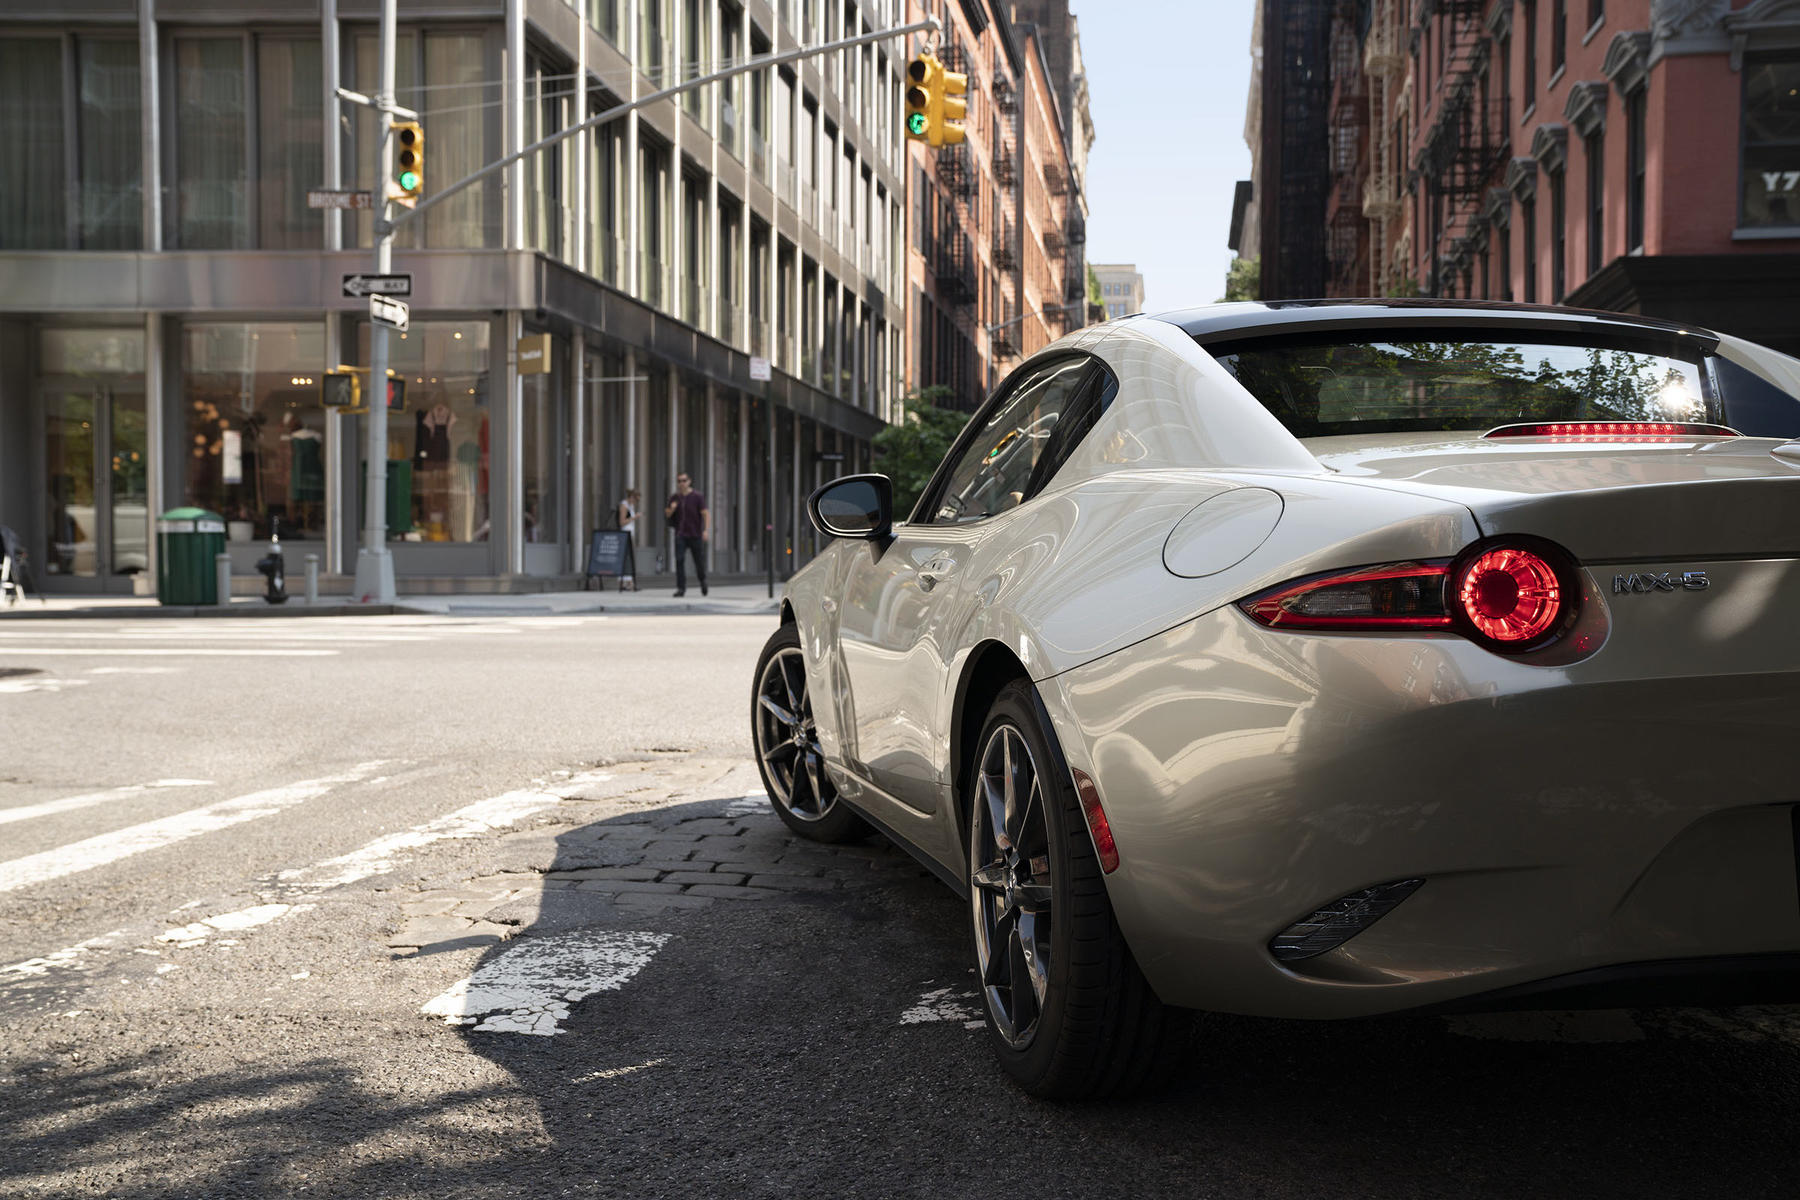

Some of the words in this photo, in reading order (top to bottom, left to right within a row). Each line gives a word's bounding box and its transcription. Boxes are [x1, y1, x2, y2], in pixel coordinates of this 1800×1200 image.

[356, 193, 370, 208] ST
[351, 281, 370, 291] ONE
[384, 281, 404, 290] WAY
[1614, 571, 1710, 593] MX-5
